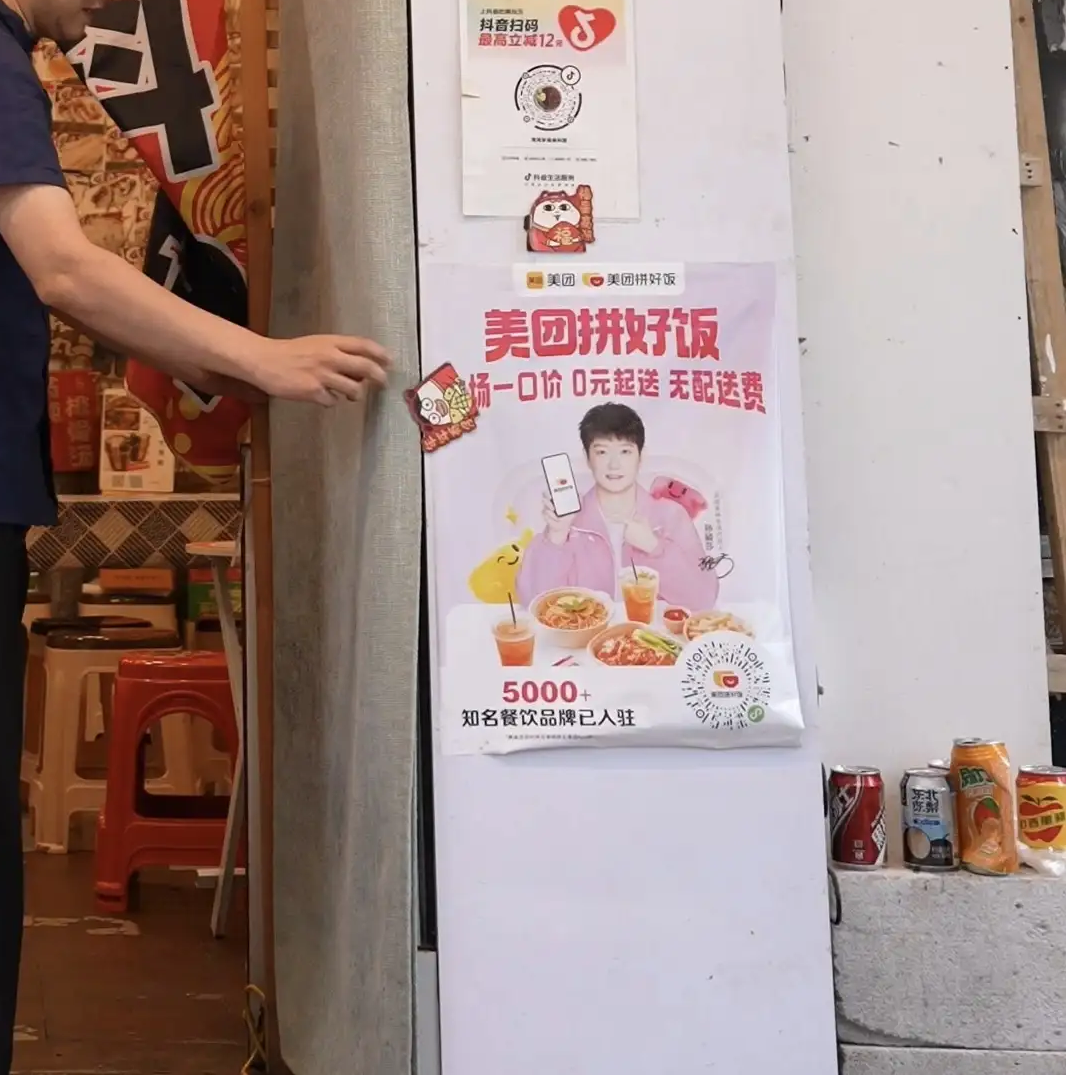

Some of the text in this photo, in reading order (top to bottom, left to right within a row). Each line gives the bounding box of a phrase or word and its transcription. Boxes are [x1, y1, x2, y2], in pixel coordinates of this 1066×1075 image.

[480, 18, 539, 32] 抖音扫码
[547, 272, 676, 286] 美团 美团拼好饭
[484, 307, 721, 363] 美团拼好饭
[572, 368, 660, 398] 0元起送
[668, 369, 767, 414] 无配送费
[502, 680, 592, 705] 5000+
[461, 708, 636, 728] 知名餐饮品牌已入驻
